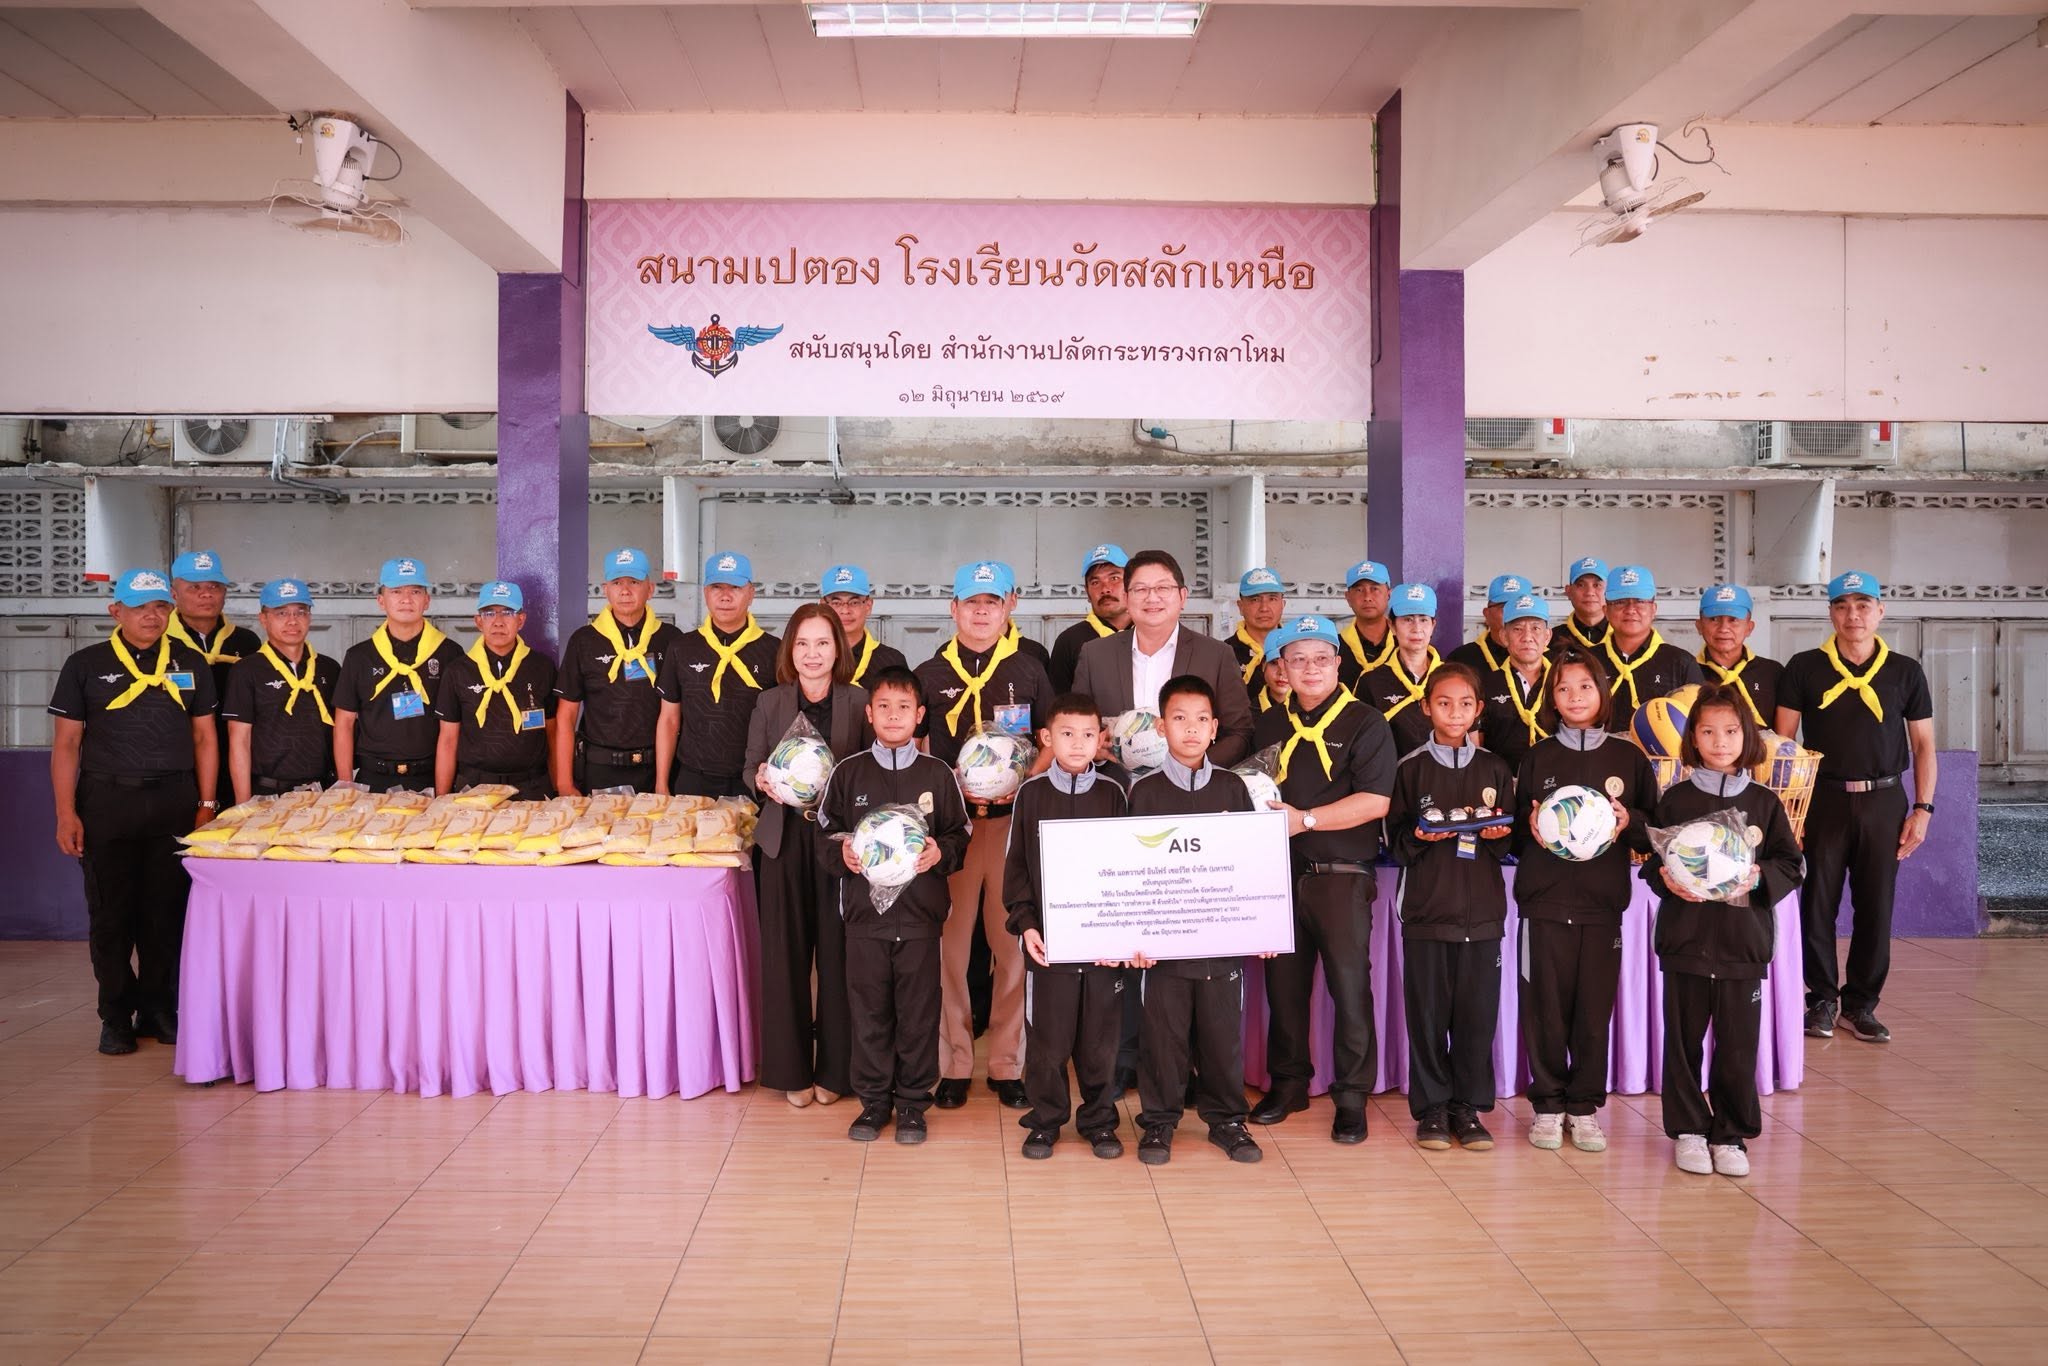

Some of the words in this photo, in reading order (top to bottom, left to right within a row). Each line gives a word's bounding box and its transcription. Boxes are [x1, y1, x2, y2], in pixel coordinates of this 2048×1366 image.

[636, 246, 880, 286] สนามเปตอง
[894, 233, 1316, 291] โรงเรียนวัดสลักเหนือ
[788, 330, 931, 369] สนับสนุนโดย
[940, 333, 1285, 363] สำนักงานปลัดกระทรวงกลาโหม
[898, 389, 925, 404] ๑๒
[931, 384, 1004, 410] มิถุนายน
[1010, 389, 1065, 403] ๒๕๖๙
[1168, 837, 1202, 854] AIS
[1097, 868, 1116, 877] บริษัท
[1191, 864, 1208, 873] จำกัด
[1208, 864, 1235, 872] (มหาชน)
